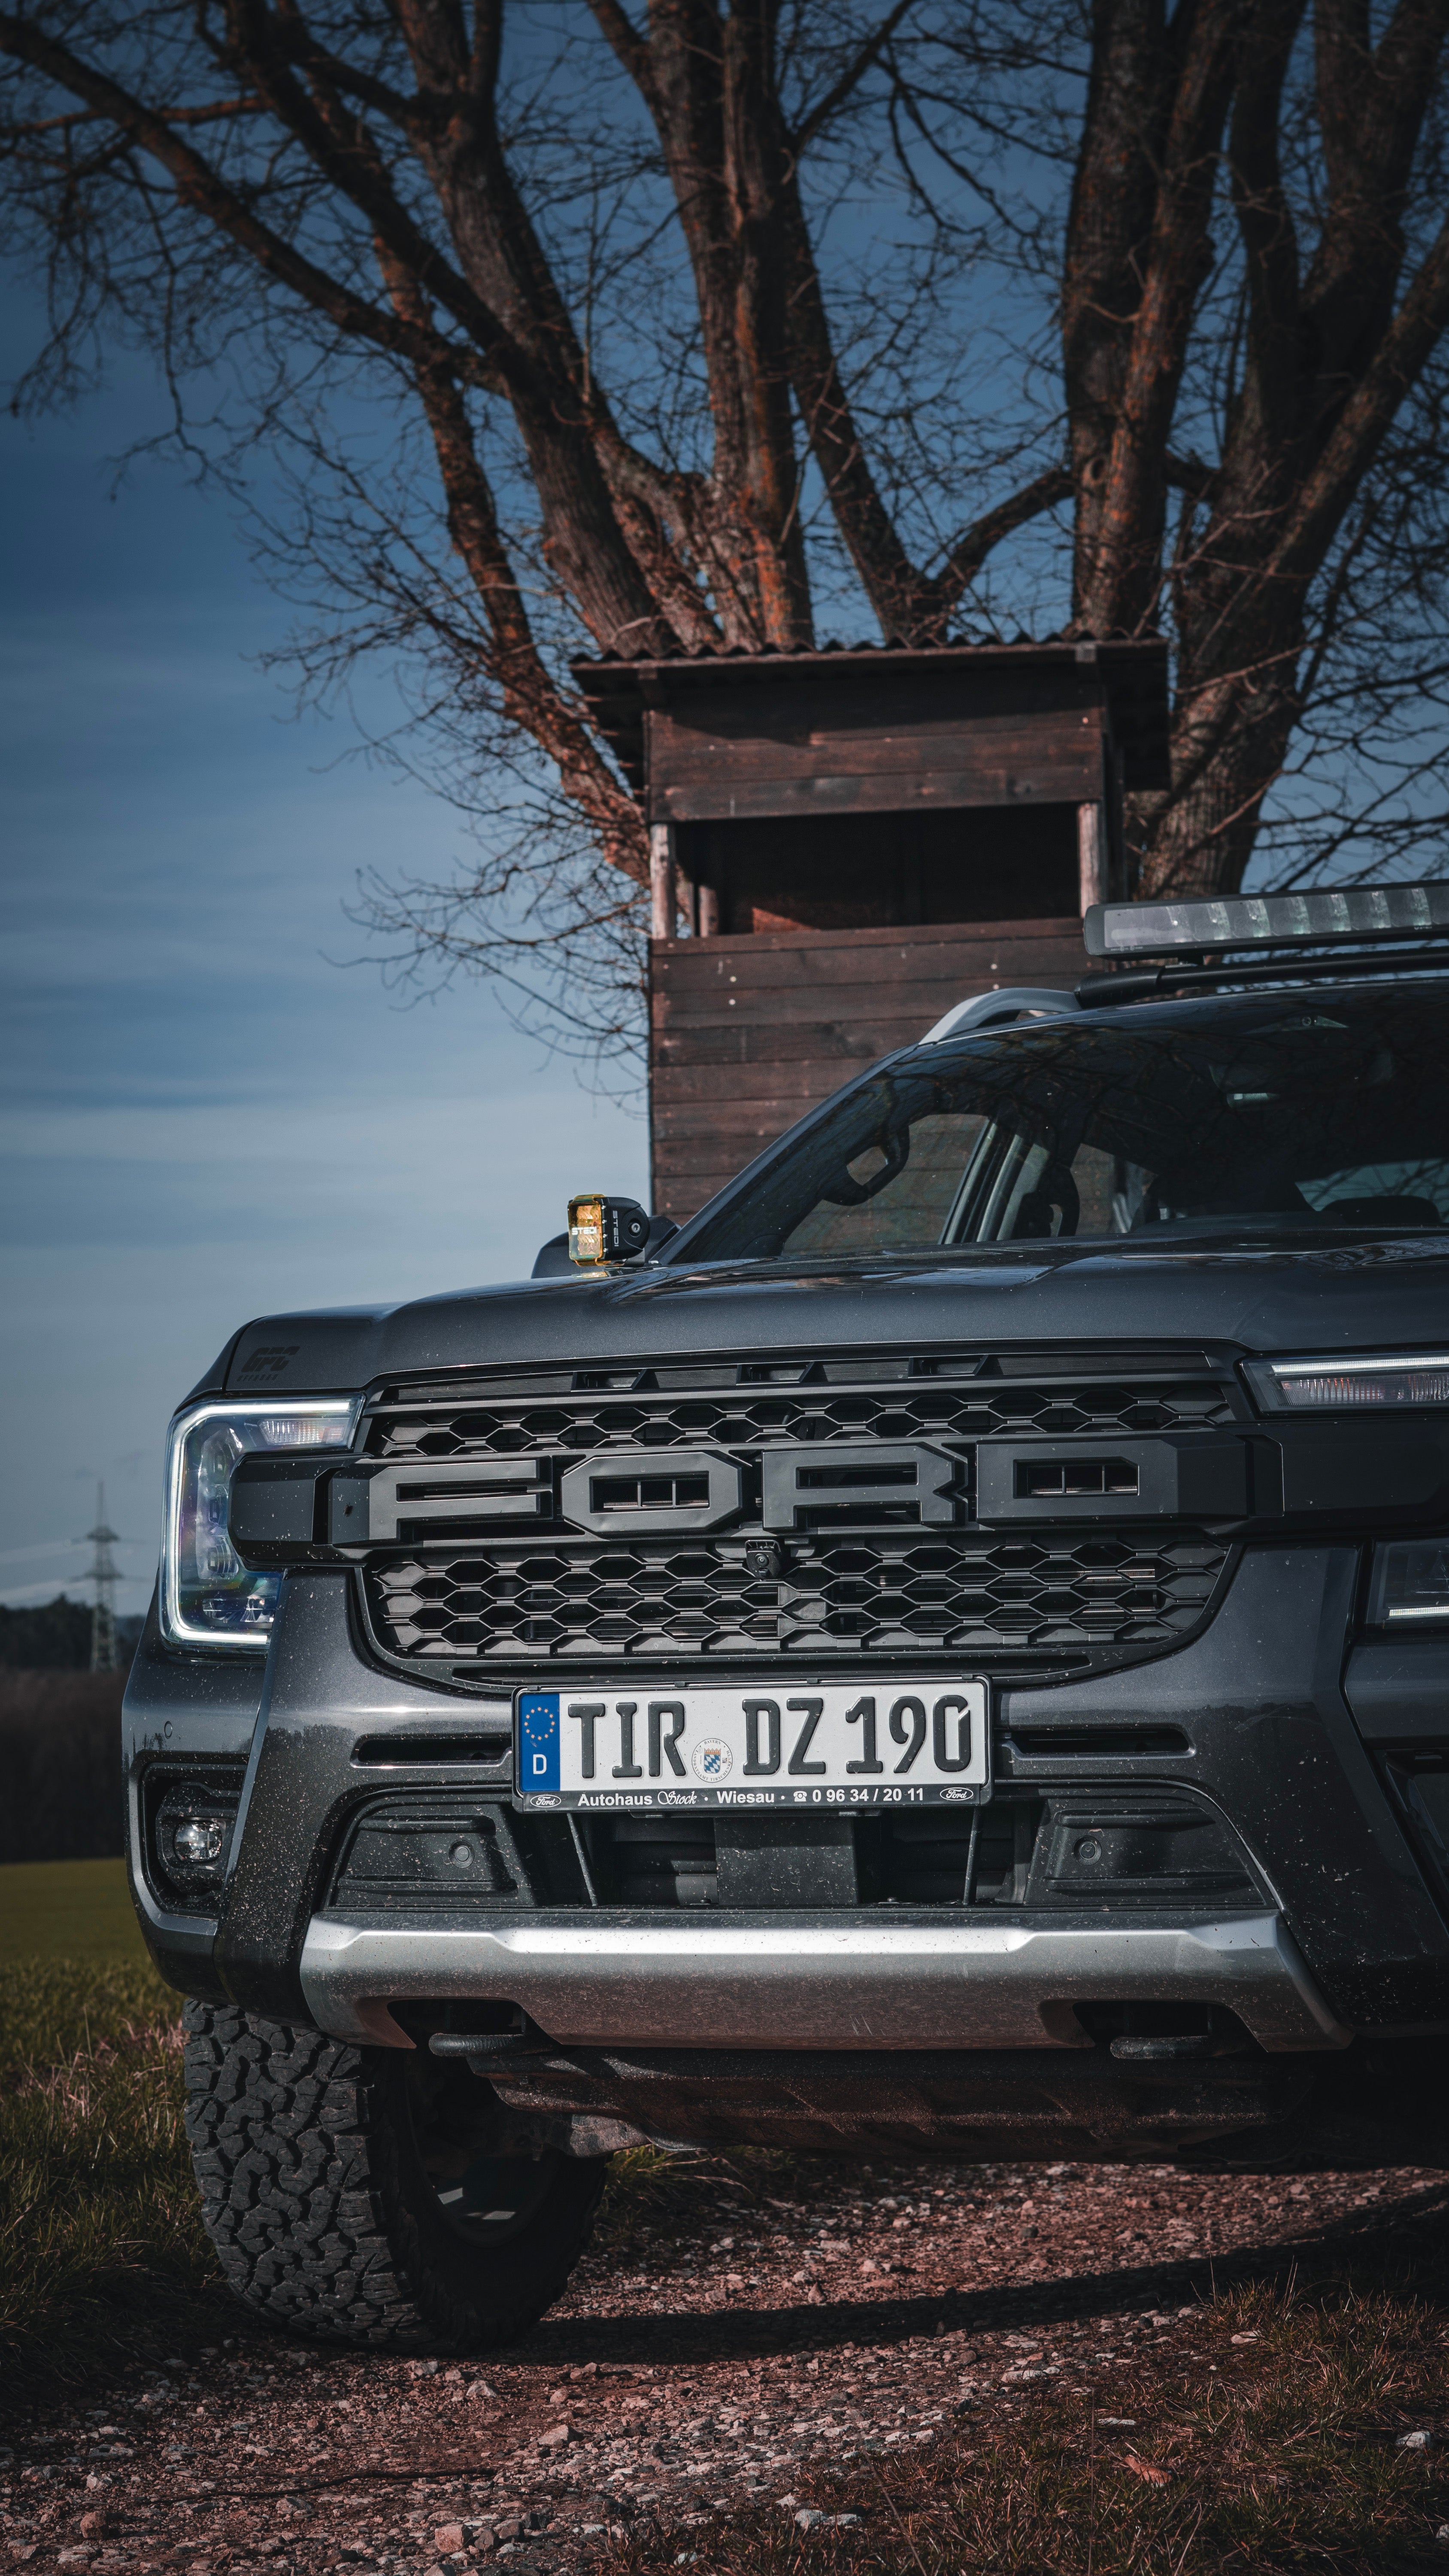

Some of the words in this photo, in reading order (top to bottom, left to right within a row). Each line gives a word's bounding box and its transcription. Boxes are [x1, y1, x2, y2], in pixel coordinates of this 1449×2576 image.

[572, 1226, 597, 1235] STEDI
[368, 1438, 1182, 1546] FORD
[568, 1701, 686, 1779] TIR
[742, 1698, 826, 1776] DZ
[845, 1695, 972, 1774] 190
[533, 1754, 547, 1774] D
[536, 1796, 555, 1805] Ford
[578, 1793, 652, 1806] Autohaus
[658, 1791, 697, 1804] Stock
[717, 1791, 774, 1803] Wiesau
[812, 1789, 821, 1802] 0
[827, 1789, 845, 1802] 96
[850, 1789, 869, 1801] 34
[883, 1789, 901, 1801] 20
[908, 1788, 923, 1801] 11
[946, 1789, 967, 1798] Ford
